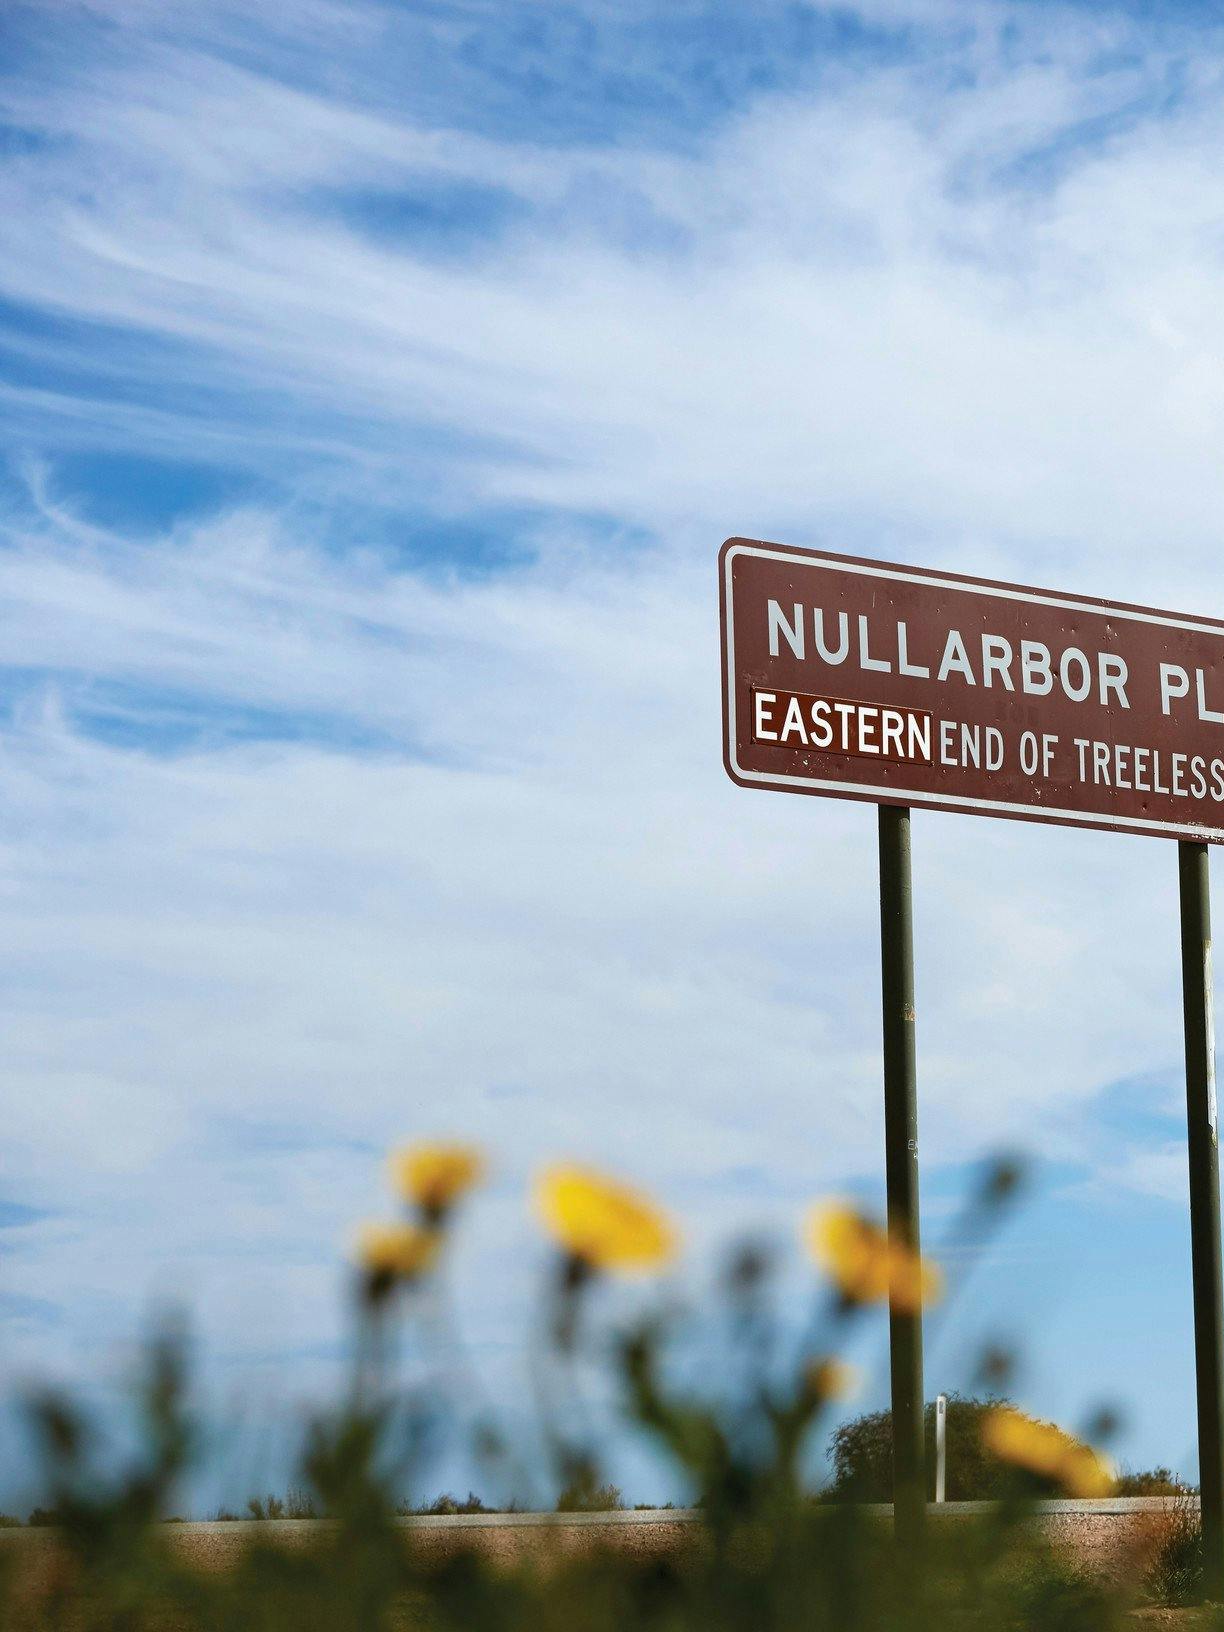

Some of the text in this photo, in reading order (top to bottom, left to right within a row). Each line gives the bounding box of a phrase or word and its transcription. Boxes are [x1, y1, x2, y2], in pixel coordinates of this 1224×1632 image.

[767, 598, 1131, 709] NULLARBOR
[755, 691, 931, 761] EASTERN
[940, 720, 1004, 771] END
[1019, 730, 1059, 778] OF
